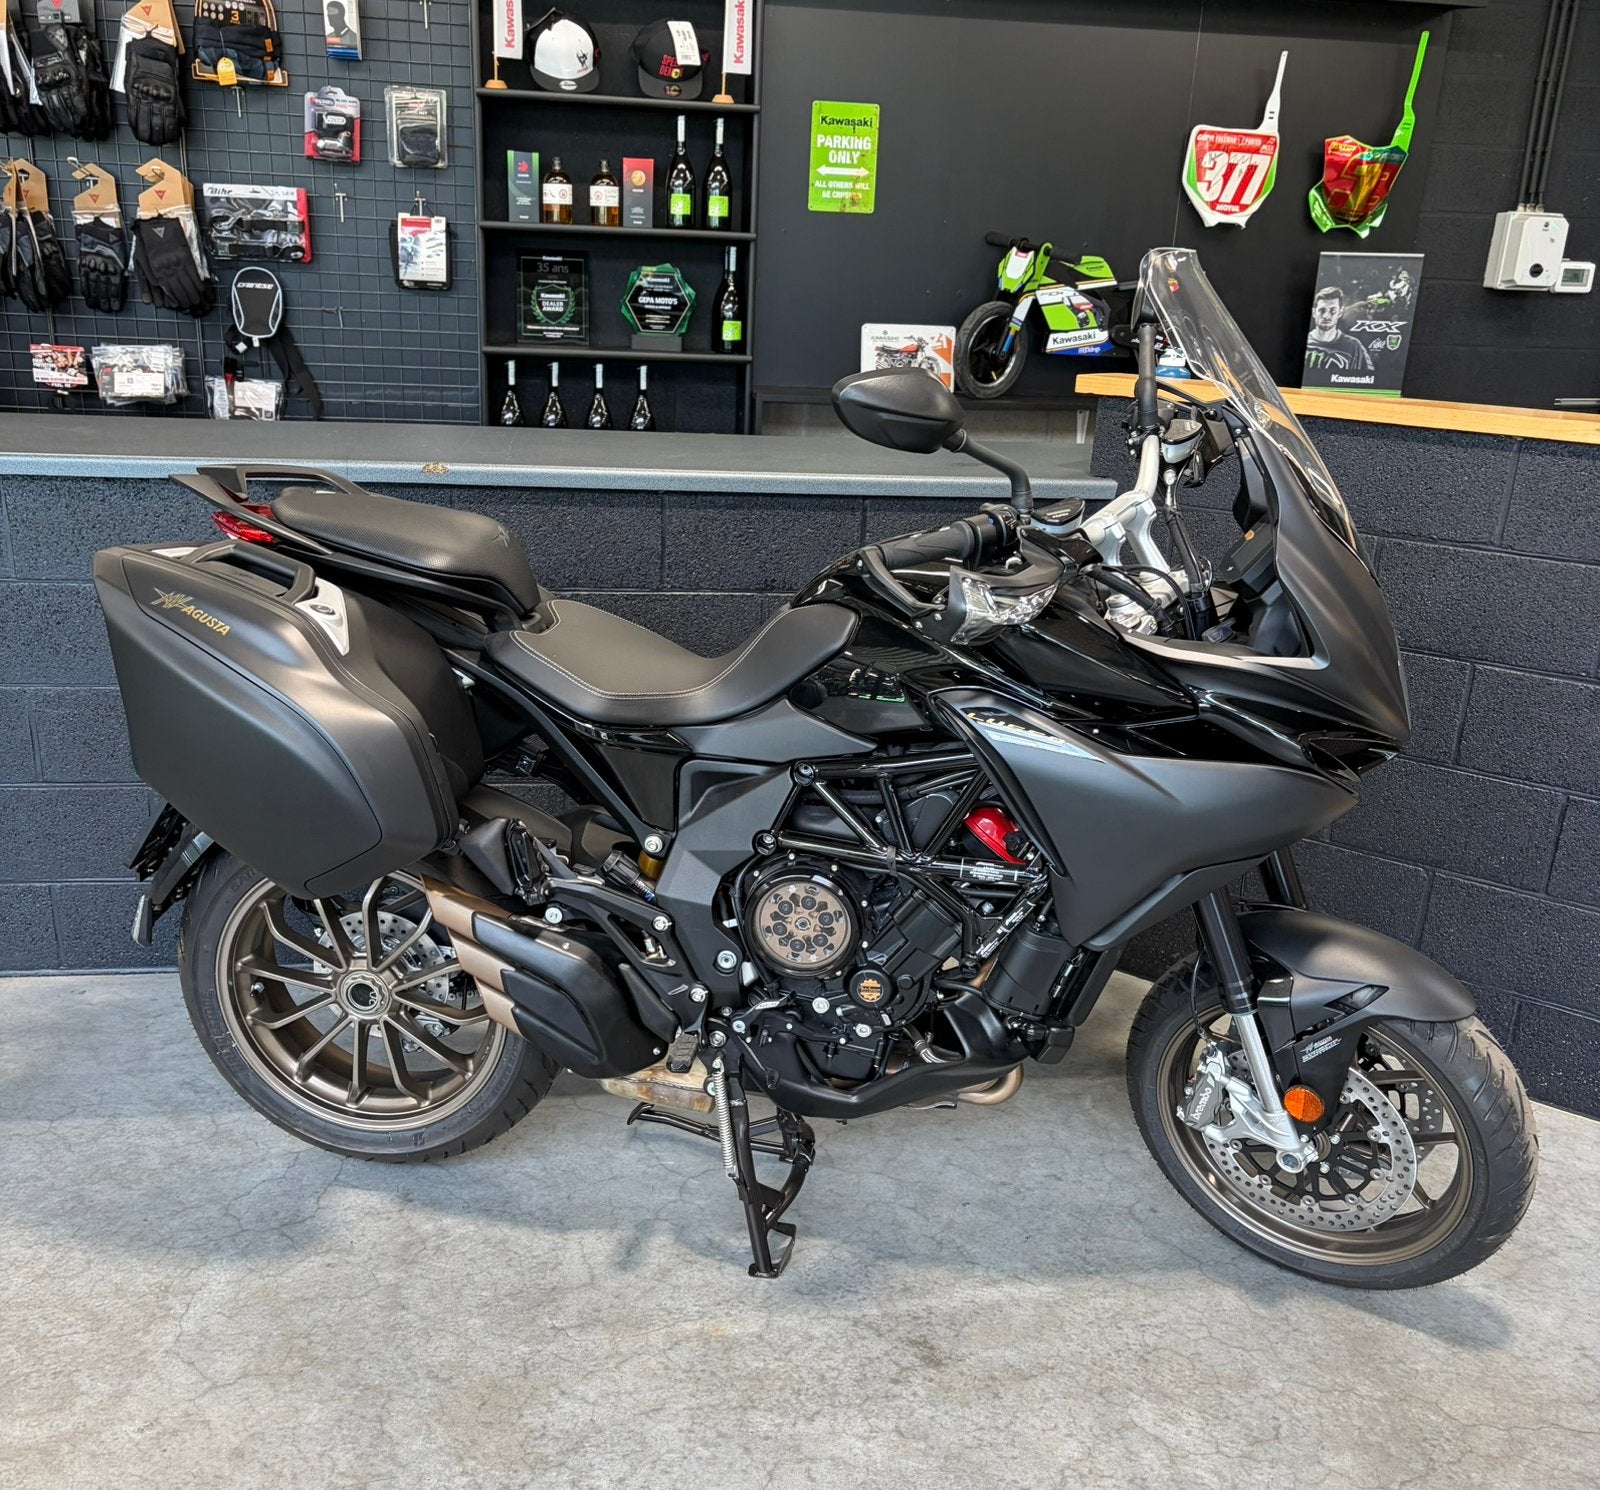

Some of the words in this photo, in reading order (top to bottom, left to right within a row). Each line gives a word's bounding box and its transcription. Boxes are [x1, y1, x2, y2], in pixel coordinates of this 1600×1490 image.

[505, 0, 515, 48] Kawas
[733, 0, 744, 64] Kawasak
[820, 115, 873, 128] Kawasaki
[816, 134, 872, 150] PARKING
[828, 149, 860, 164] ONLY
[1196, 150, 1272, 206] 377
[1349, 319, 1408, 333] KX
[1052, 330, 1097, 346] Kawasaki
[1330, 373, 1375, 384] Kawasaki
[181, 605, 232, 636] AGUSTA
[1190, 1087, 1213, 1121] brembo
